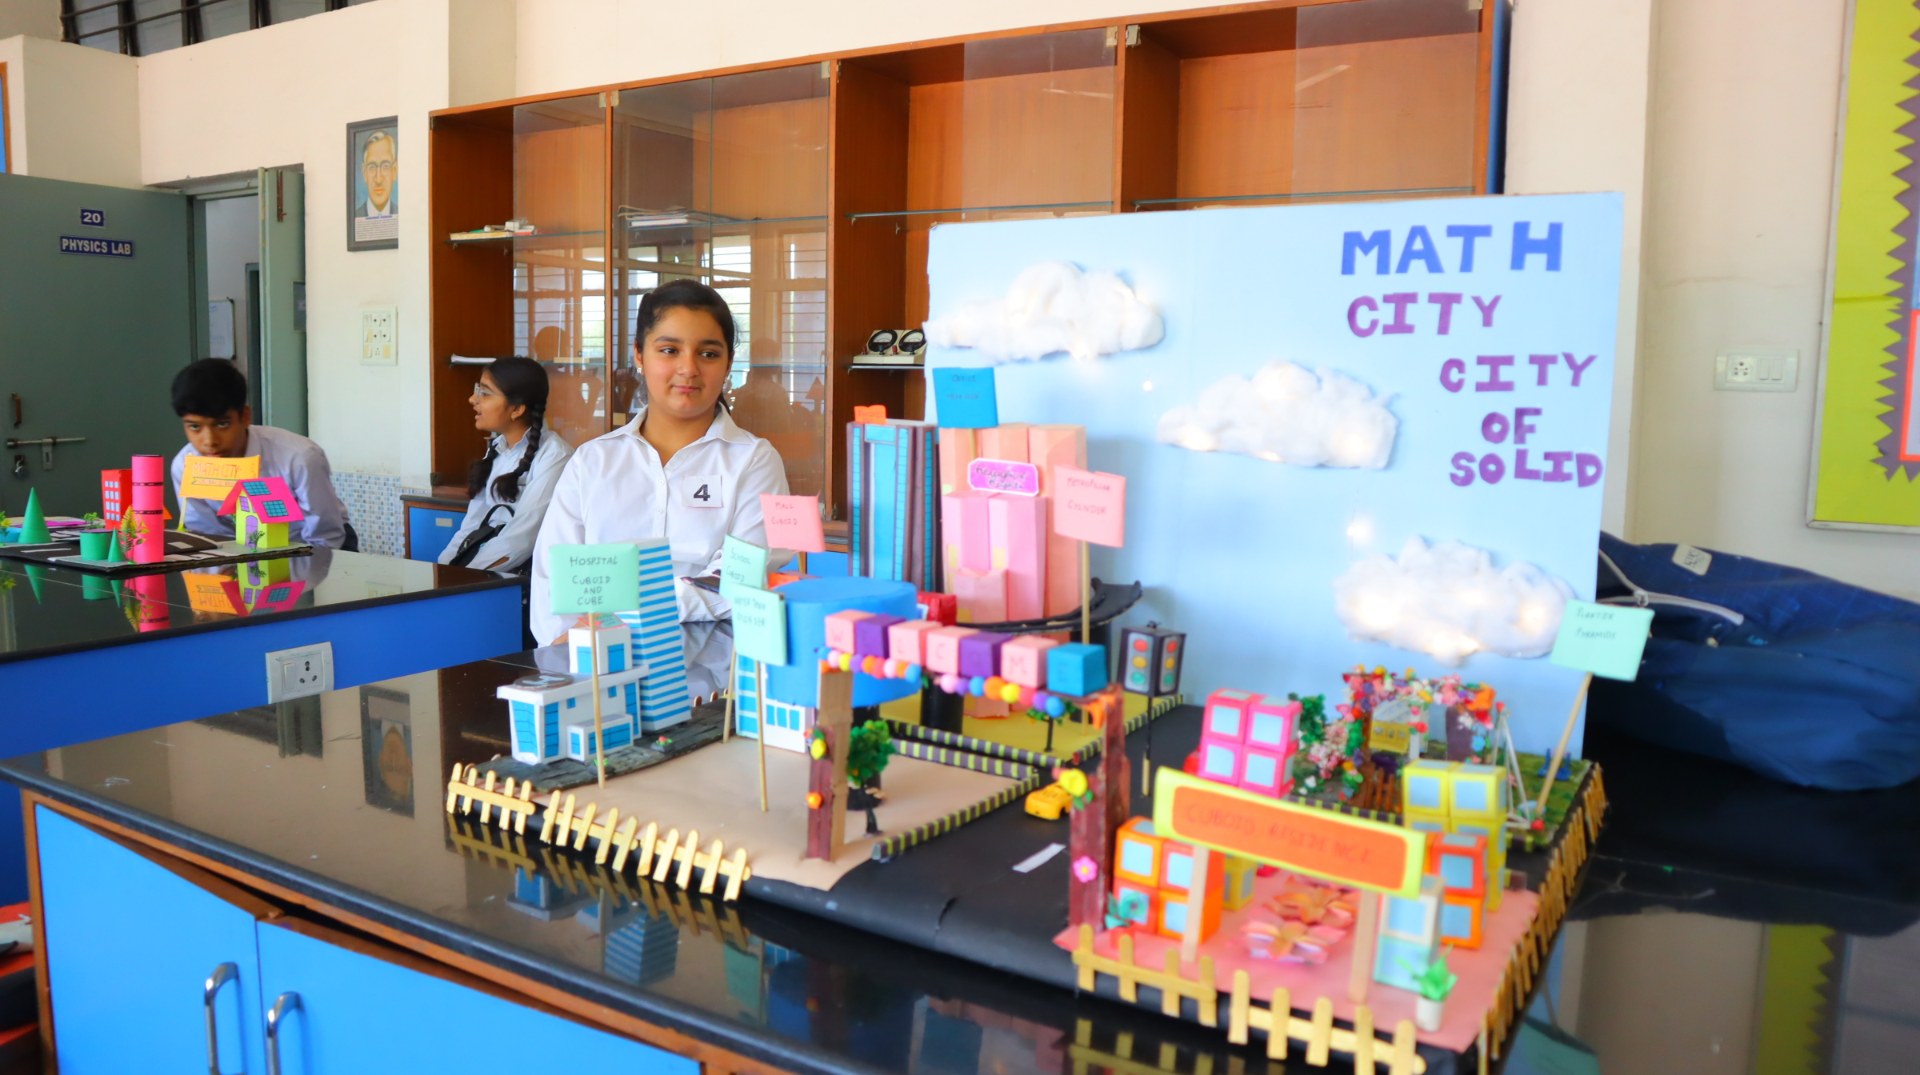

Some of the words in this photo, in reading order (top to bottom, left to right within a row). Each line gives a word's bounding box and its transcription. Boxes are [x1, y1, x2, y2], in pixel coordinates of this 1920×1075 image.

[83, 212, 101, 223] 20
[62, 238, 107, 253] PHYSICS
[111, 242, 131, 255] LAB
[1341, 221, 1563, 275] MATH
[1347, 292, 1502, 338] CITY
[1439, 352, 1598, 393] CITY
[1481, 407, 1542, 444] OF
[1449, 448, 1603, 488] SOLID
[693, 484, 711, 502] 4
[569, 556, 618, 567] HOSPITAL
[572, 575, 611, 585] CUBOID
[584, 586, 602, 595] AND
[577, 596, 604, 606] CUBE
[1186, 804, 1256, 836] CUBOID
